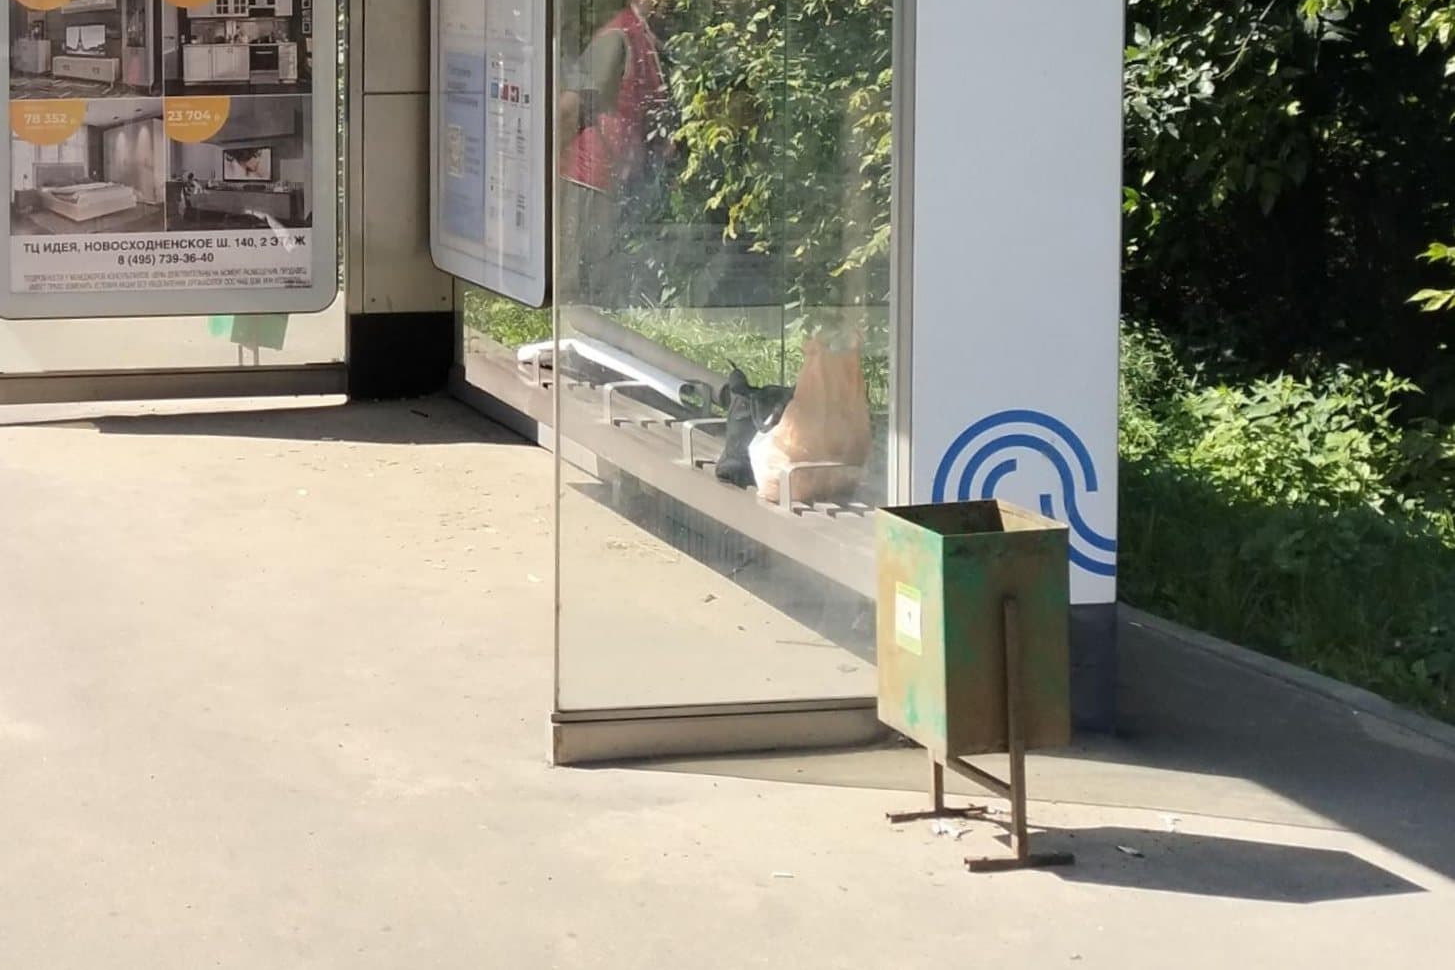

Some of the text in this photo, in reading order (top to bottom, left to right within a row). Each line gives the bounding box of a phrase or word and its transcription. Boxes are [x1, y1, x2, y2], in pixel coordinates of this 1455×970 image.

[24, 243, 40, 254] ТЦ
[43, 242, 80, 254] ИДЕЯ,
[84, 238, 213, 252] НОВОСХОДНЕНСКОЕ
[216, 238, 231, 248] Ш.
[235, 237, 258, 249] 140,
[260, 237, 267, 247] 2
[117, 252, 215, 267] 8 (495) 739-36-40
